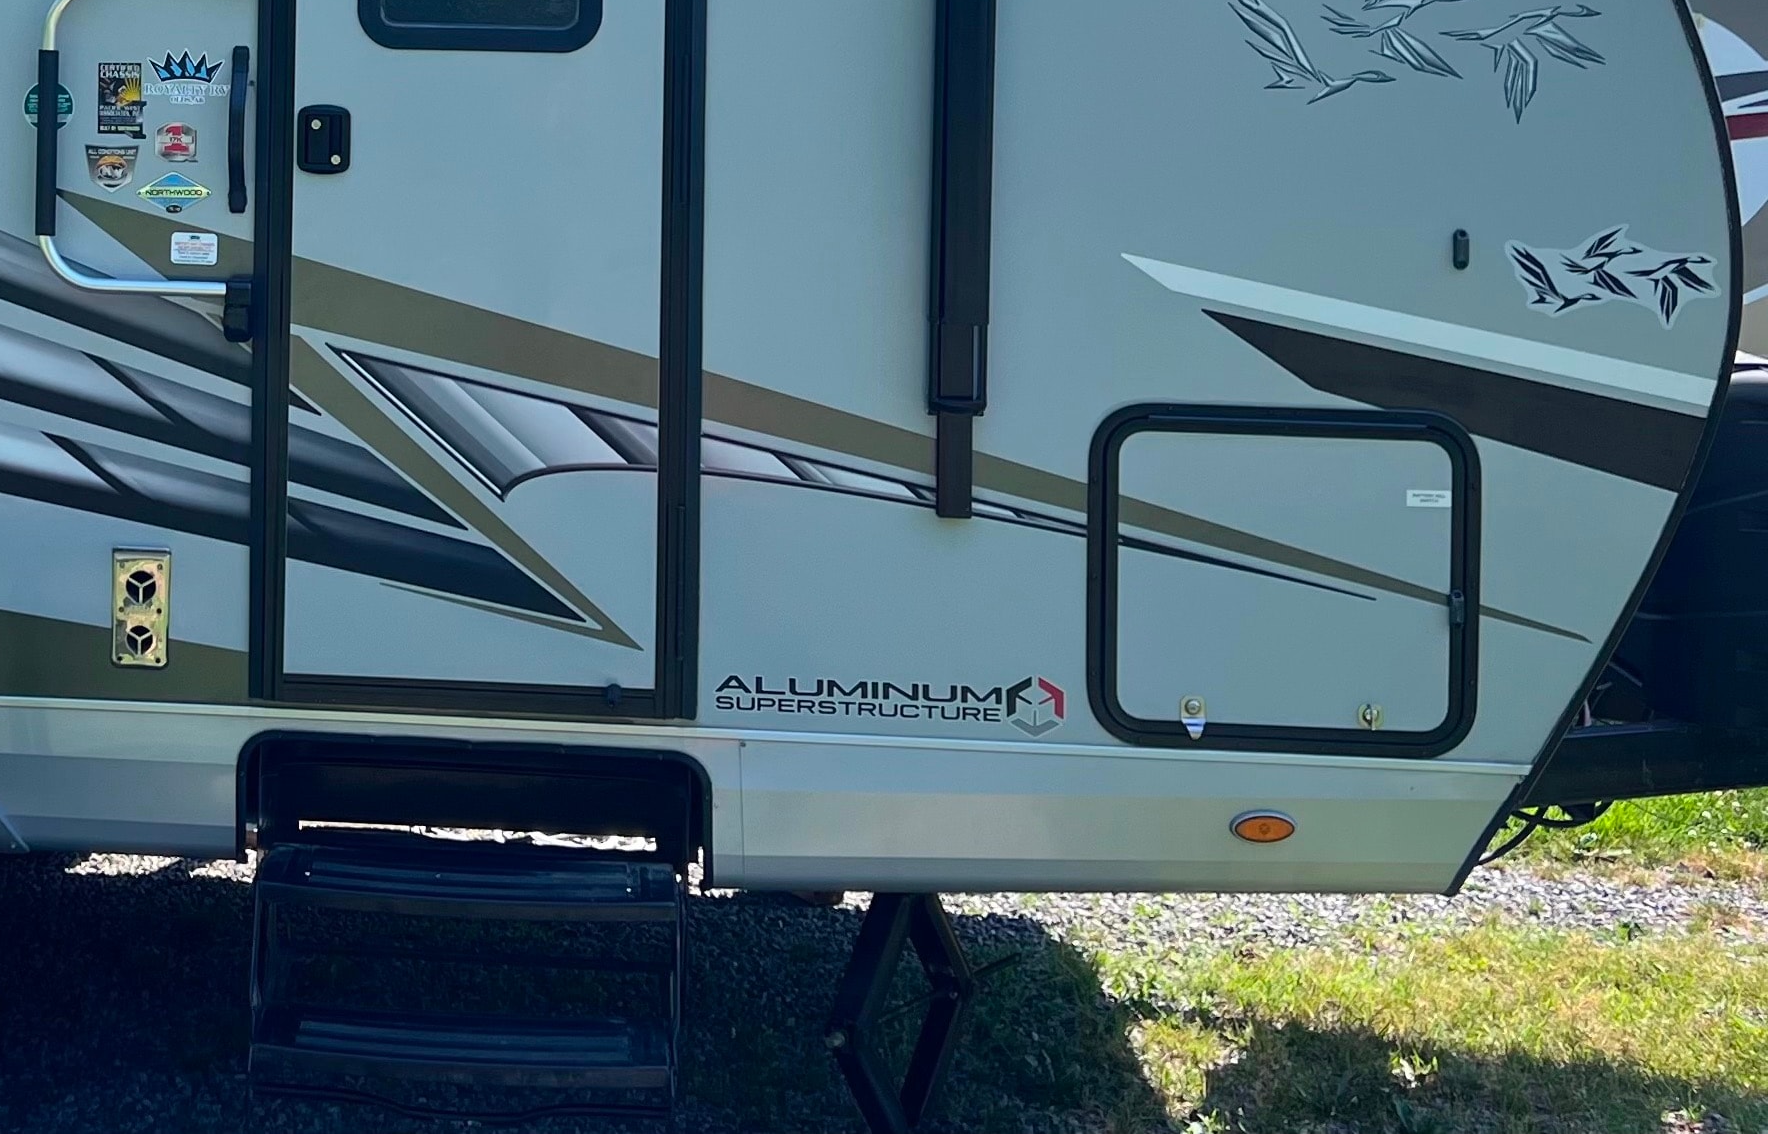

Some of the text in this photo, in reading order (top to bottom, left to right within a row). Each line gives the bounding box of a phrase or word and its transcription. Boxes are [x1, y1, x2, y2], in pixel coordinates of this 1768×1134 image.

[144, 83, 230, 96] ROYALTY RV
[715, 675, 1002, 705] ALUMINUM
[715, 696, 1001, 722] SUPERSTRUCTURE
